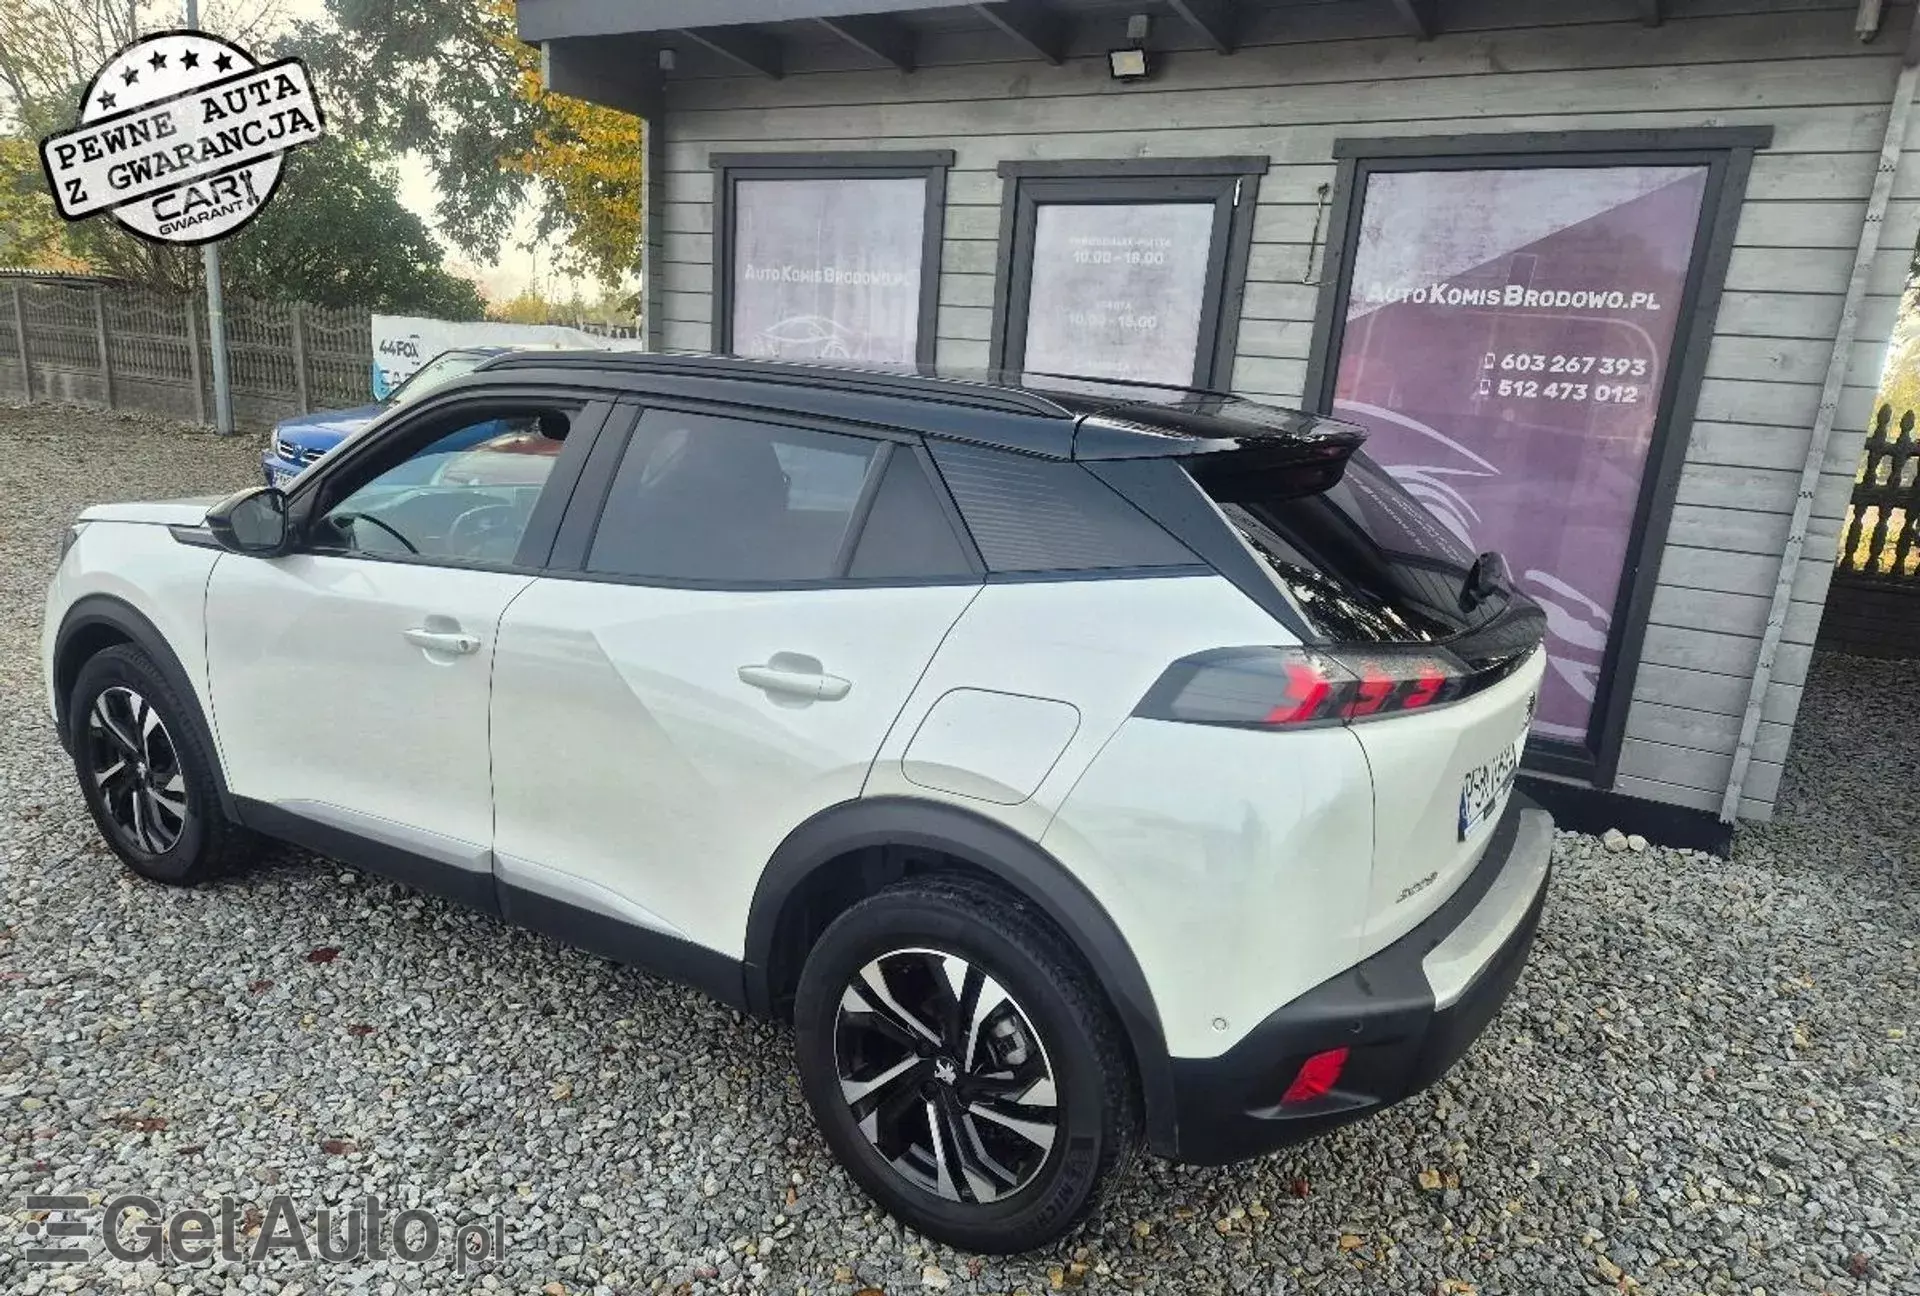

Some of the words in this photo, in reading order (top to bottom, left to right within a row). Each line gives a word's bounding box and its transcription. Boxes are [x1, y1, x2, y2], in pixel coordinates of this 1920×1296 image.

[1501, 353, 1545, 372] 603
[1550, 356, 1597, 374] 267
[1598, 358, 1646, 376] 393
[1497, 380, 1537, 399] 512
[1544, 382, 1588, 401] 473
[1594, 384, 1638, 404] 012
